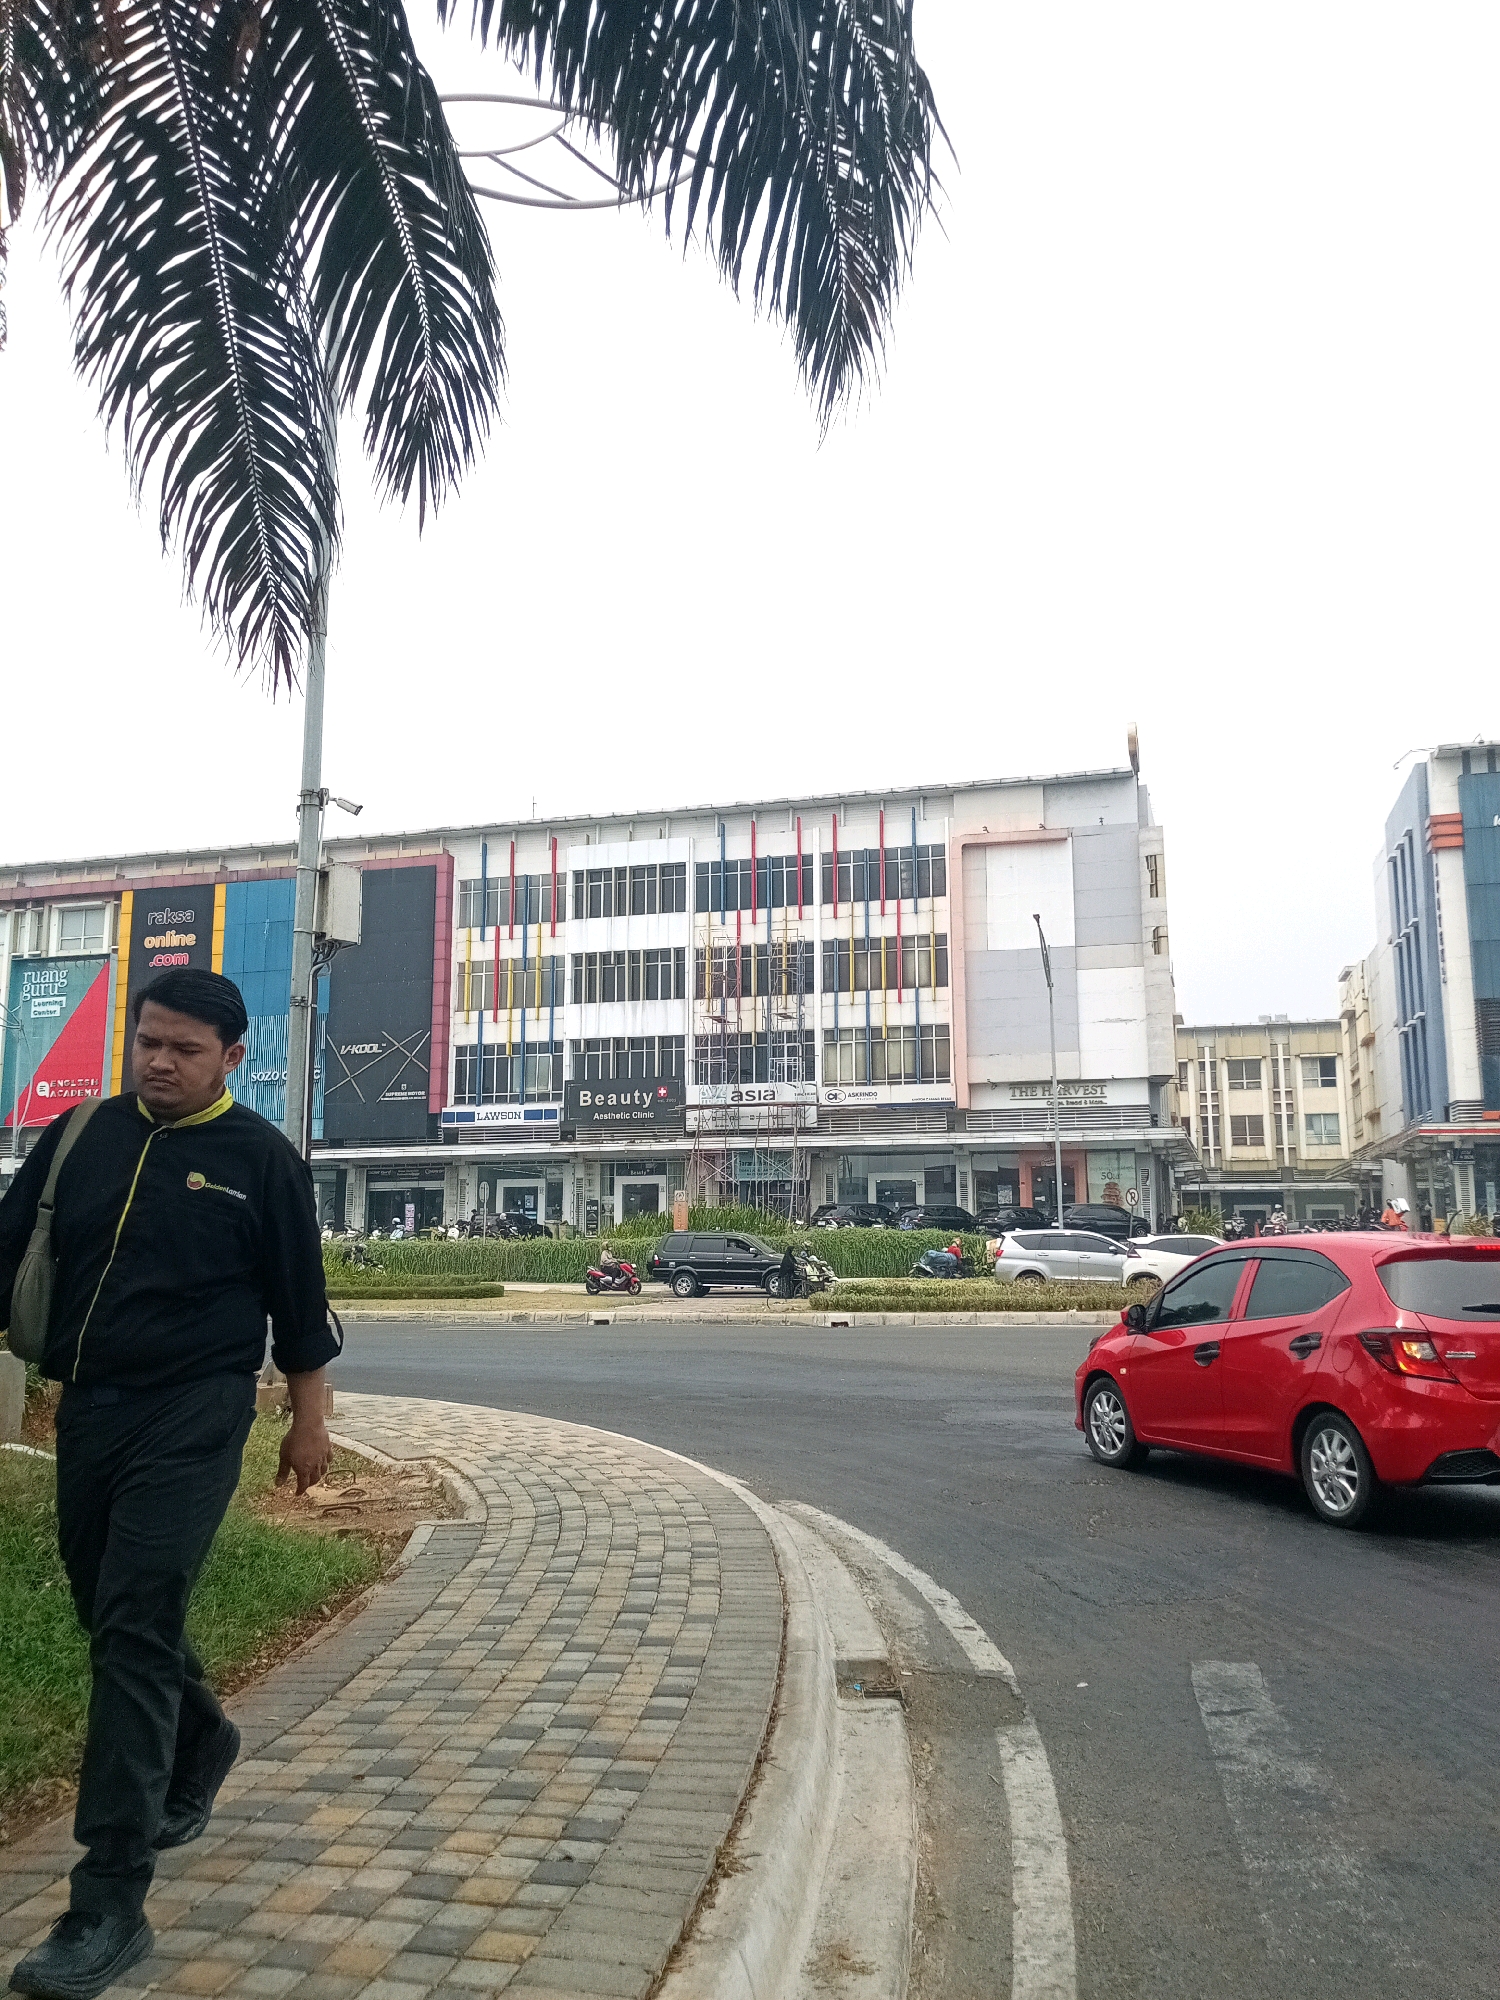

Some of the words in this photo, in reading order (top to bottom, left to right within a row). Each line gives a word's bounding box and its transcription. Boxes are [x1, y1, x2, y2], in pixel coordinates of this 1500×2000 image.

[147, 907, 195, 925] raksa
[143, 929, 197, 949] online
[148, 952, 189, 968] .com
[22, 969, 69, 988] ruang
[21, 982, 67, 1001] guru
[340, 1043, 383, 1055] V-KOOL
[250, 1070, 280, 1082] SOZO
[50, 1079, 99, 1088] ENGLISH
[50, 1088, 99, 1098] ACADEMY
[730, 1089, 776, 1102] asia
[1009, 1085, 1037, 1097] THE
[579, 1088, 654, 1109] Beauty
[476, 1111, 522, 1121] LAWSON
[593, 1111, 631, 1120] Aesthetic
[632, 1111, 655, 1119] Clinic
